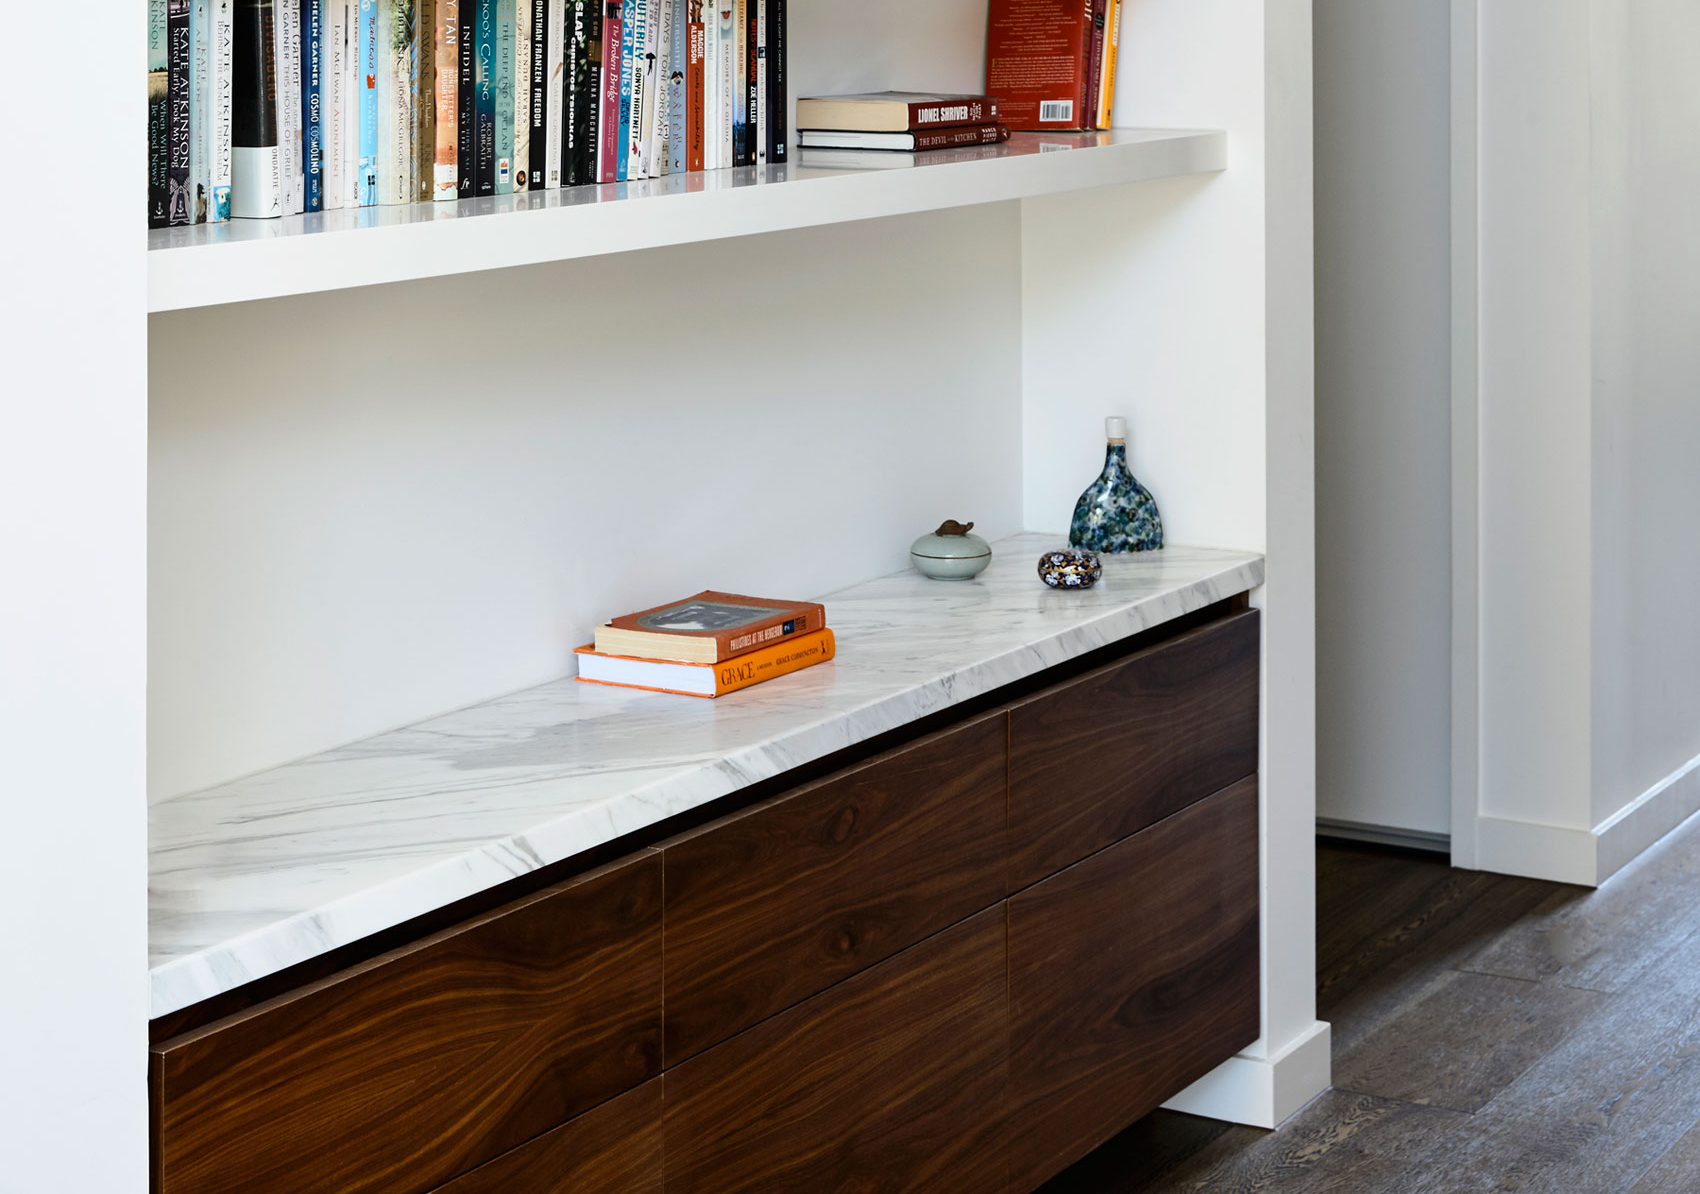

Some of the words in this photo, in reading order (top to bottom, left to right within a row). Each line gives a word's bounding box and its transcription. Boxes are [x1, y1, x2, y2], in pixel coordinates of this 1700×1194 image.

[446, 14, 456, 44] TAN
[575, 1, 584, 41] SLAP
[180, 27, 188, 69] KATE
[462, 26, 470, 85] INFIDEL
[534, 44, 542, 82] FRANZEN
[611, 38, 619, 70] Broken
[481, 43, 490, 101] CALLING
[590, 66, 598, 98] MELINA
[621, 49, 632, 96] JONES
[661, 52, 669, 81] TONI
[607, 72, 618, 102] Bridge
[152, 104, 158, 116] Be
[180, 77, 188, 168] ATKINSON
[310, 93, 319, 122] COSMO
[533, 88, 542, 127] FREEDOM
[632, 97, 640, 139] HARTNETT
[657, 86, 667, 137] JORDAN
[918, 108, 939, 123] LIONEL
[940, 106, 968, 122] SHRIVER
[172, 126, 179, 142] My
[589, 103, 597, 152] MARCHETTA
[954, 133, 977, 142] KITCHEN
[171, 146, 179, 167] Dog
[310, 126, 319, 174] COSMOLINO
[752, 633, 756, 644] AT
[765, 624, 783, 641] HEDGEROW
[776, 655, 790, 666] GRACE
[791, 647, 818, 661] CODDINGTON
[721, 661, 755, 686] GRACE
